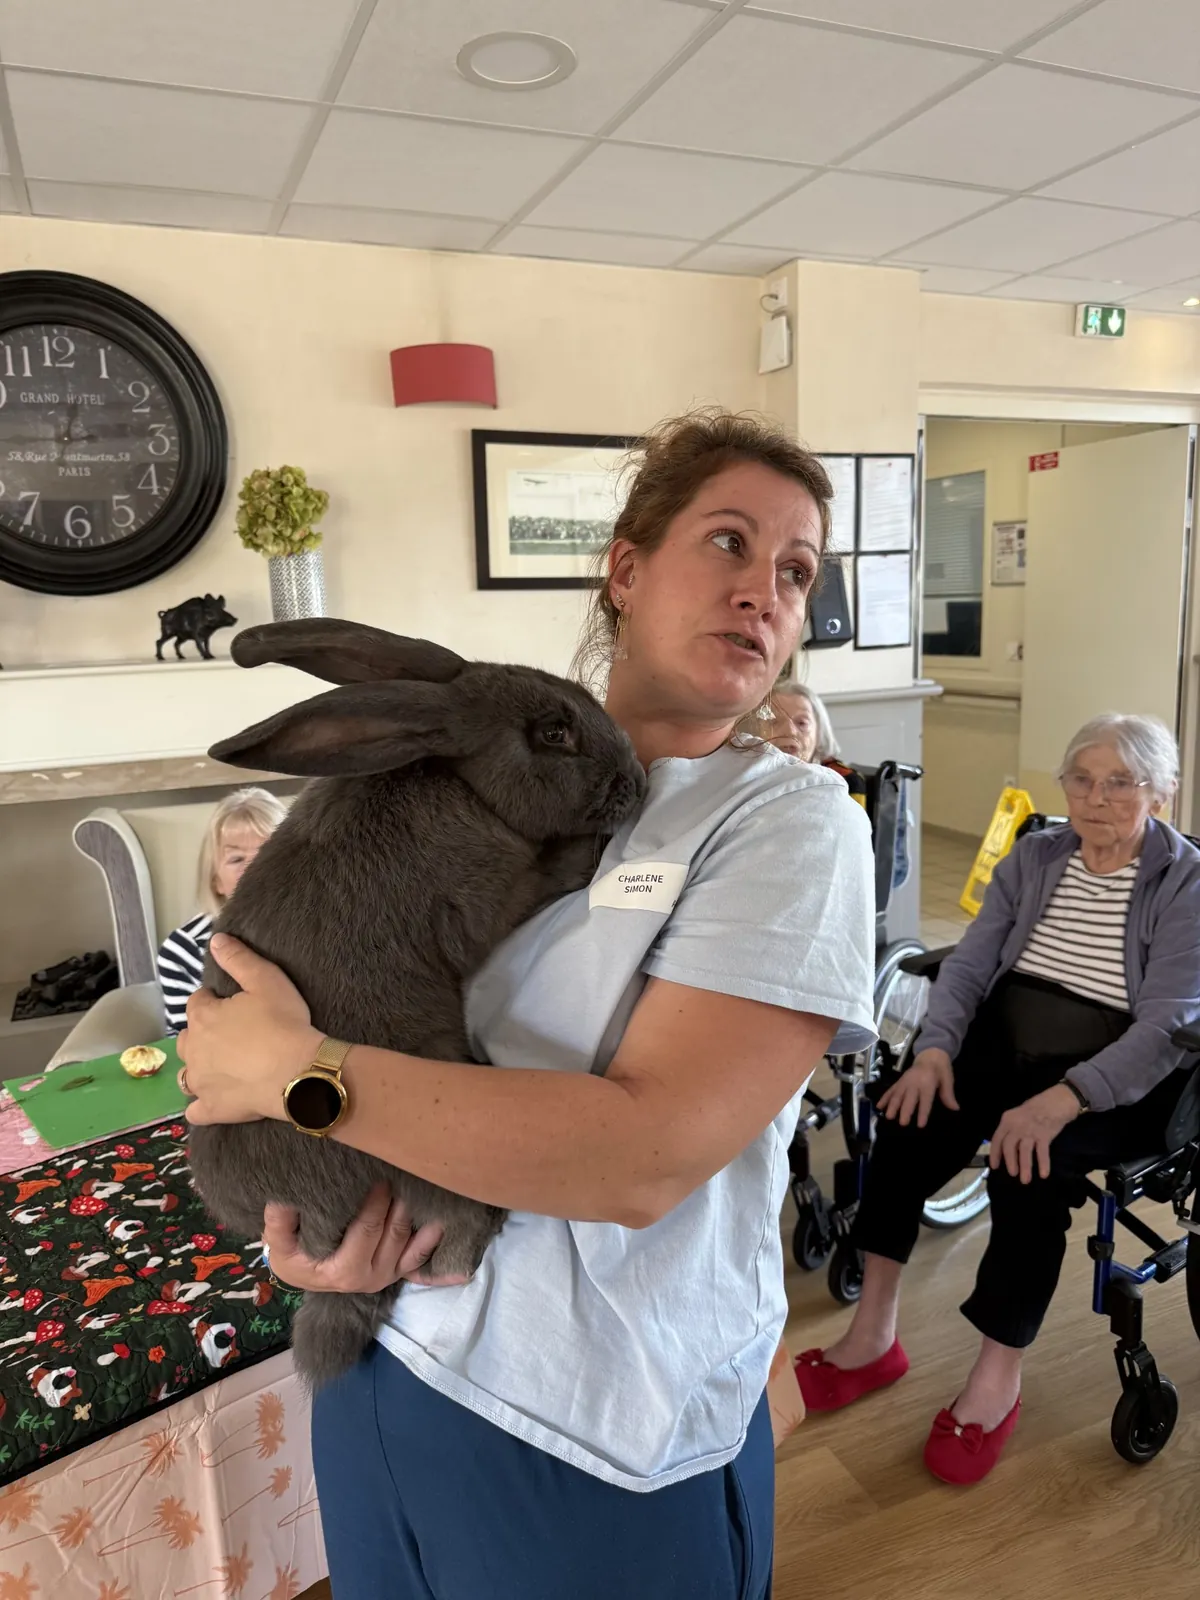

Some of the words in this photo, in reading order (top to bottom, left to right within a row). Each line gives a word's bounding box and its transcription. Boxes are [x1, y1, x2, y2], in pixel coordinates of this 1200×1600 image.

[4, 344, 33, 377] 11
[42, 335, 75, 368] 12
[99, 347, 110, 379] 1
[20, 391, 60, 404] GRAND
[66, 392, 106, 406] HOTEL
[128, 380, 151, 413] 2
[148, 423, 170, 456] 3
[58, 466, 91, 477] PARIS
[137, 463, 161, 495] 4
[18, 491, 41, 526] 7
[63, 504, 92, 540] 6
[111, 494, 136, 528] 5
[618, 873, 664, 884] CHARLENE
[624, 884, 653, 894] SIMON
